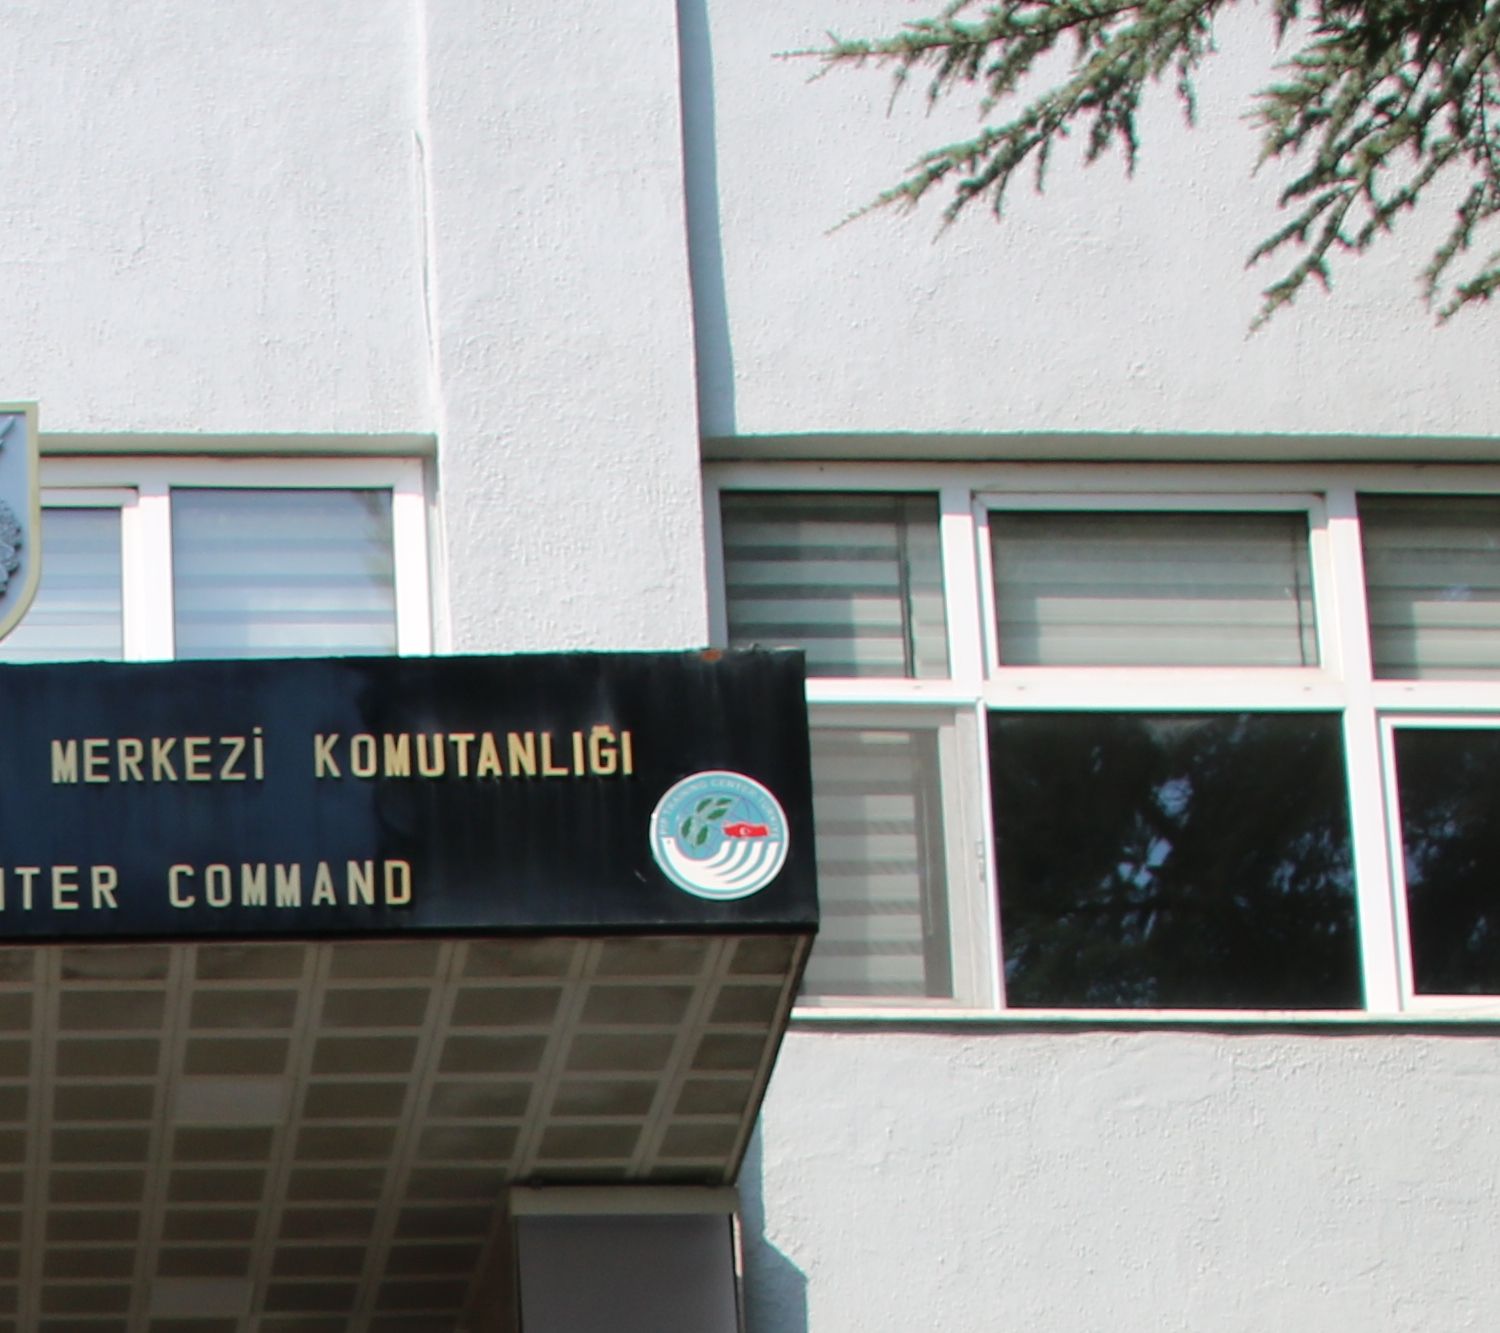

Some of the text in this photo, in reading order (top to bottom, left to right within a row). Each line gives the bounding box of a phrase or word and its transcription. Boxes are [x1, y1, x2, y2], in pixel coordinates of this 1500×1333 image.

[51, 727, 264, 784] MERKEZİ
[314, 724, 633, 778] KOMUTANLIĞI
[664, 780, 708, 814] TRAINING
[711, 779, 758, 795] CENTER
[168, 860, 411, 908] COMMAND
